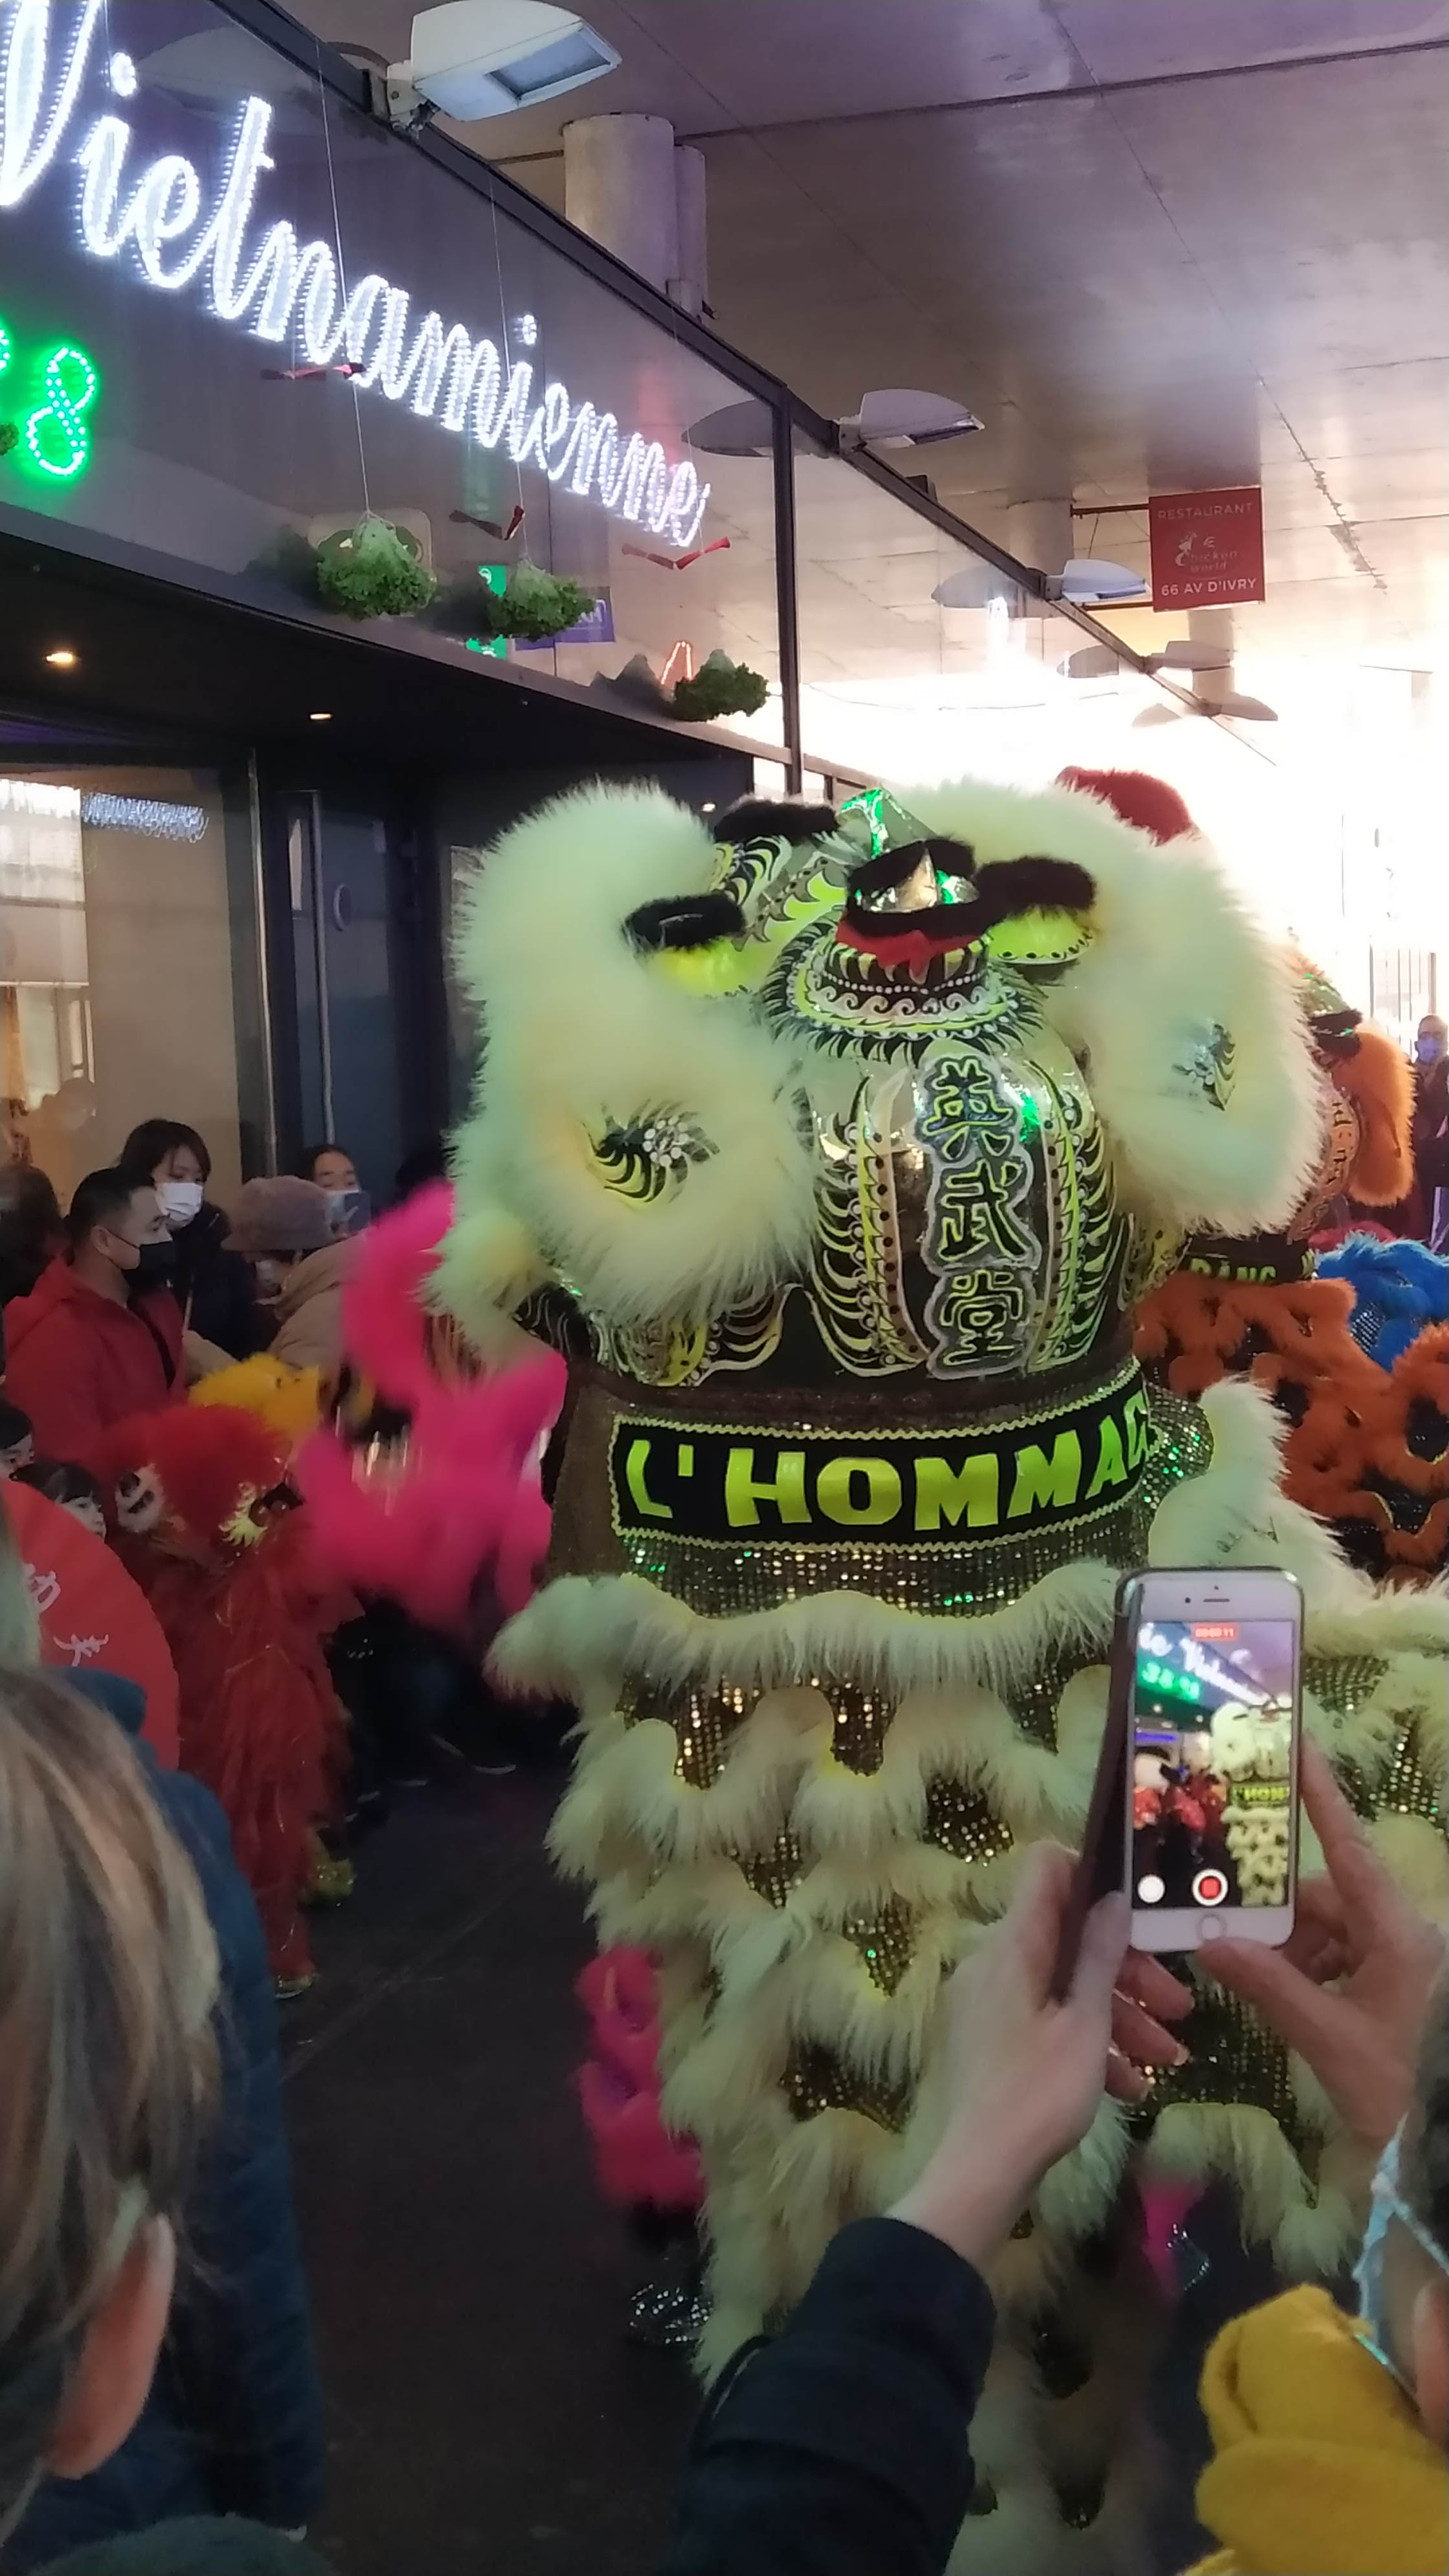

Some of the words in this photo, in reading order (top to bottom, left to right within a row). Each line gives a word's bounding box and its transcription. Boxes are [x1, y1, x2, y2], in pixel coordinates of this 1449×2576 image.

[1158, 502, 1252, 520] RESTAURANT
[1161, 584, 1179, 596] 66
[1184, 582, 1202, 594] AV
[1208, 578, 1256, 592] D'IVRY
